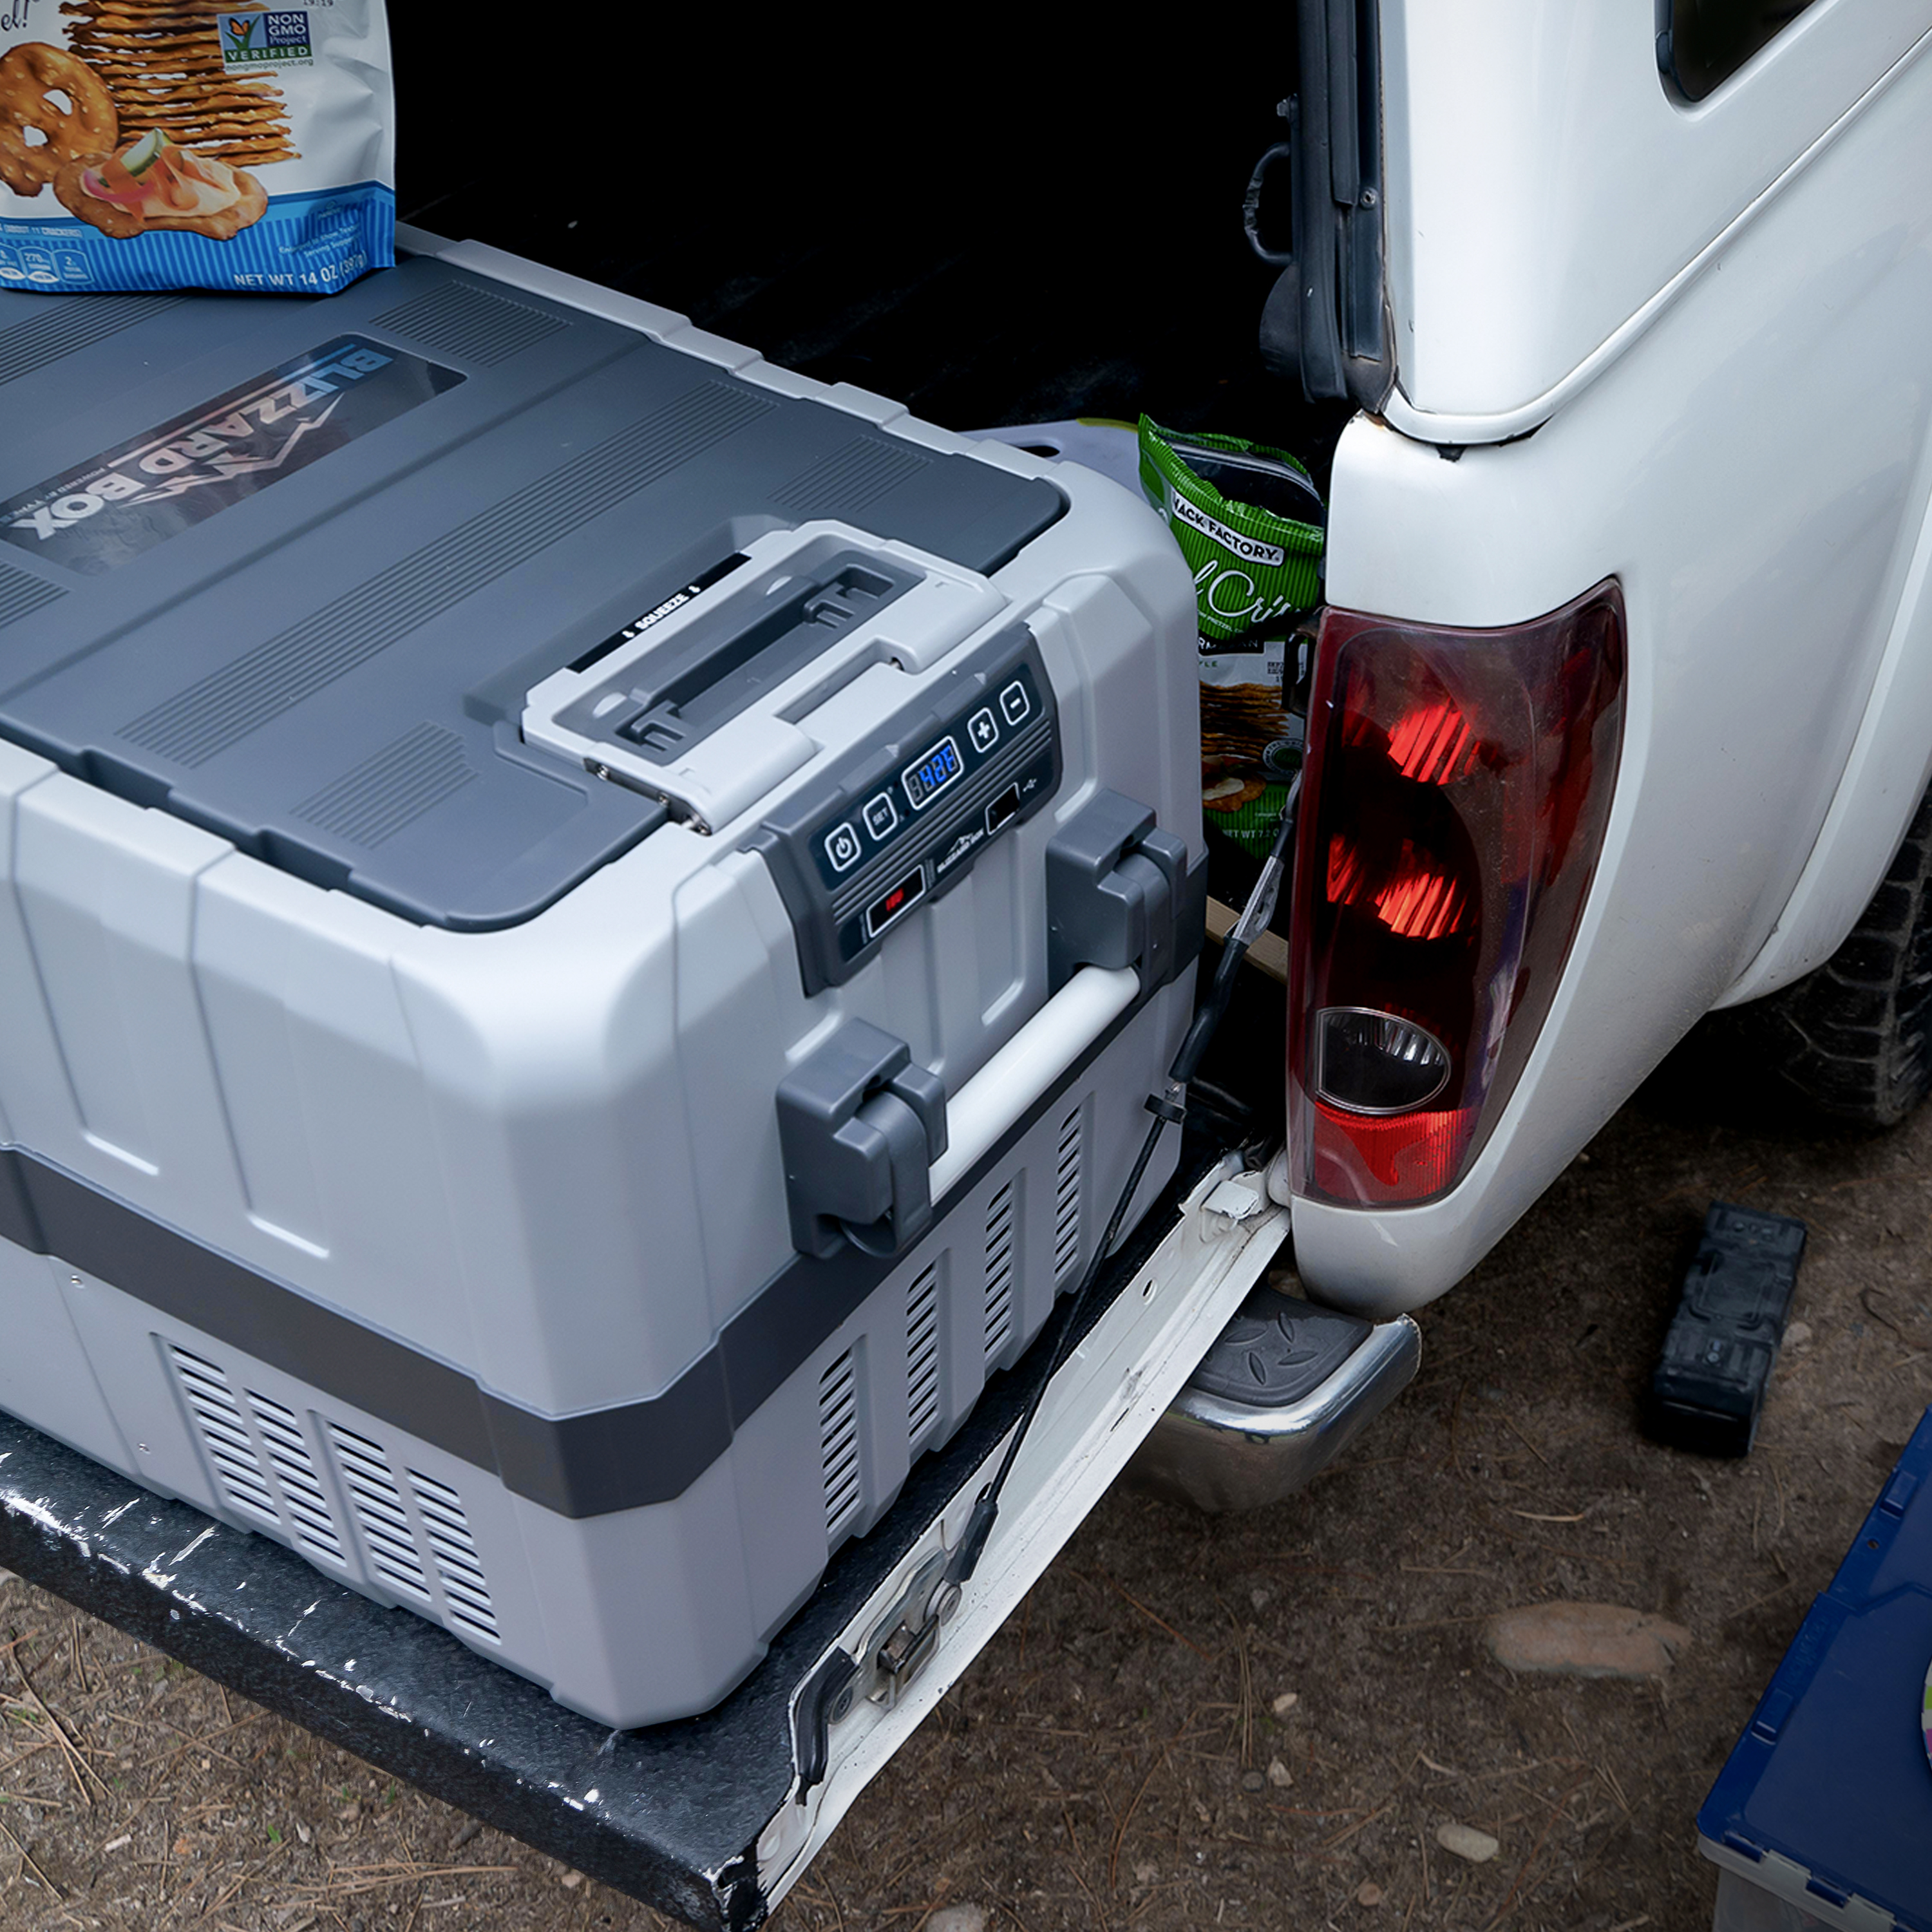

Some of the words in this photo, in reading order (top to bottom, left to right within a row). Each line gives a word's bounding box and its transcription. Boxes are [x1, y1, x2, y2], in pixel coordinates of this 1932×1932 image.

[268, 14, 305, 25] NON
[268, 24, 307, 36] GMO
[269, 35, 307, 45] Project
[227, 46, 308, 61] VERIFIED
[226, 59, 314, 71] nongmoproject.org
[234, 274, 263, 286] NET
[269, 274, 293, 286] WT
[299, 272, 317, 286] 14
[320, 265, 338, 283] OZ
[139, 348, 393, 475] BLIZZARD
[8, 473, 146, 540] BOX
[634, 593, 690, 630] SQUEEZE
[872, 807, 889, 826] SET
[1240, 829, 1256, 839] WT
